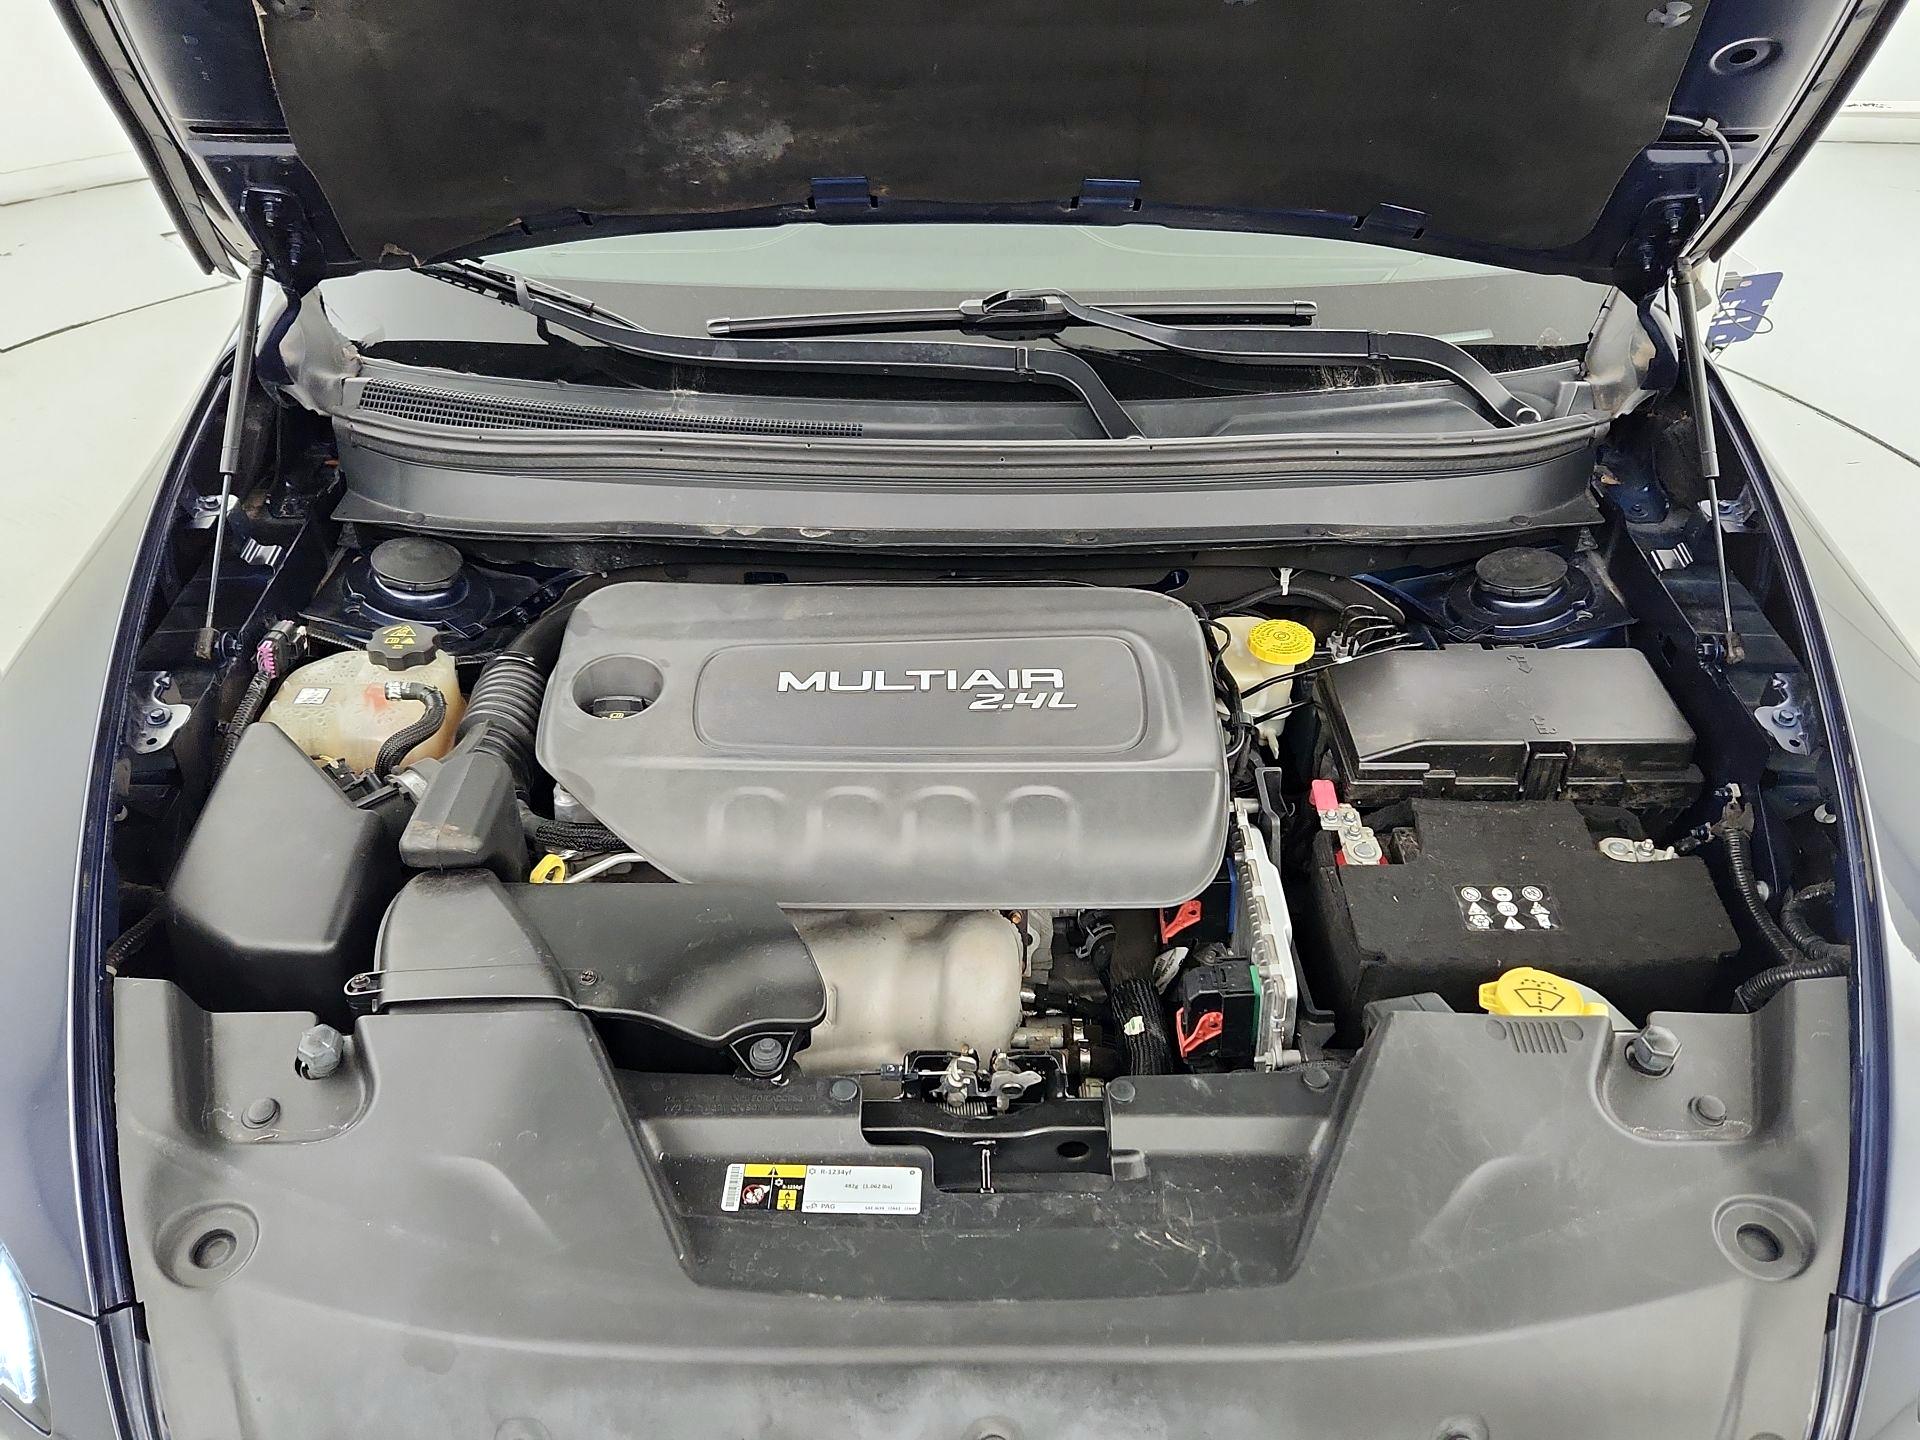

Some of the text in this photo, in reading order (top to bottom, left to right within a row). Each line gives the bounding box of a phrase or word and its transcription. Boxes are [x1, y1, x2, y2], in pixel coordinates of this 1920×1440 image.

[777, 668, 1065, 692] MULTIAIR
[968, 691, 1078, 711] 2.4L
[820, 1168, 853, 1176] R-1234yf
